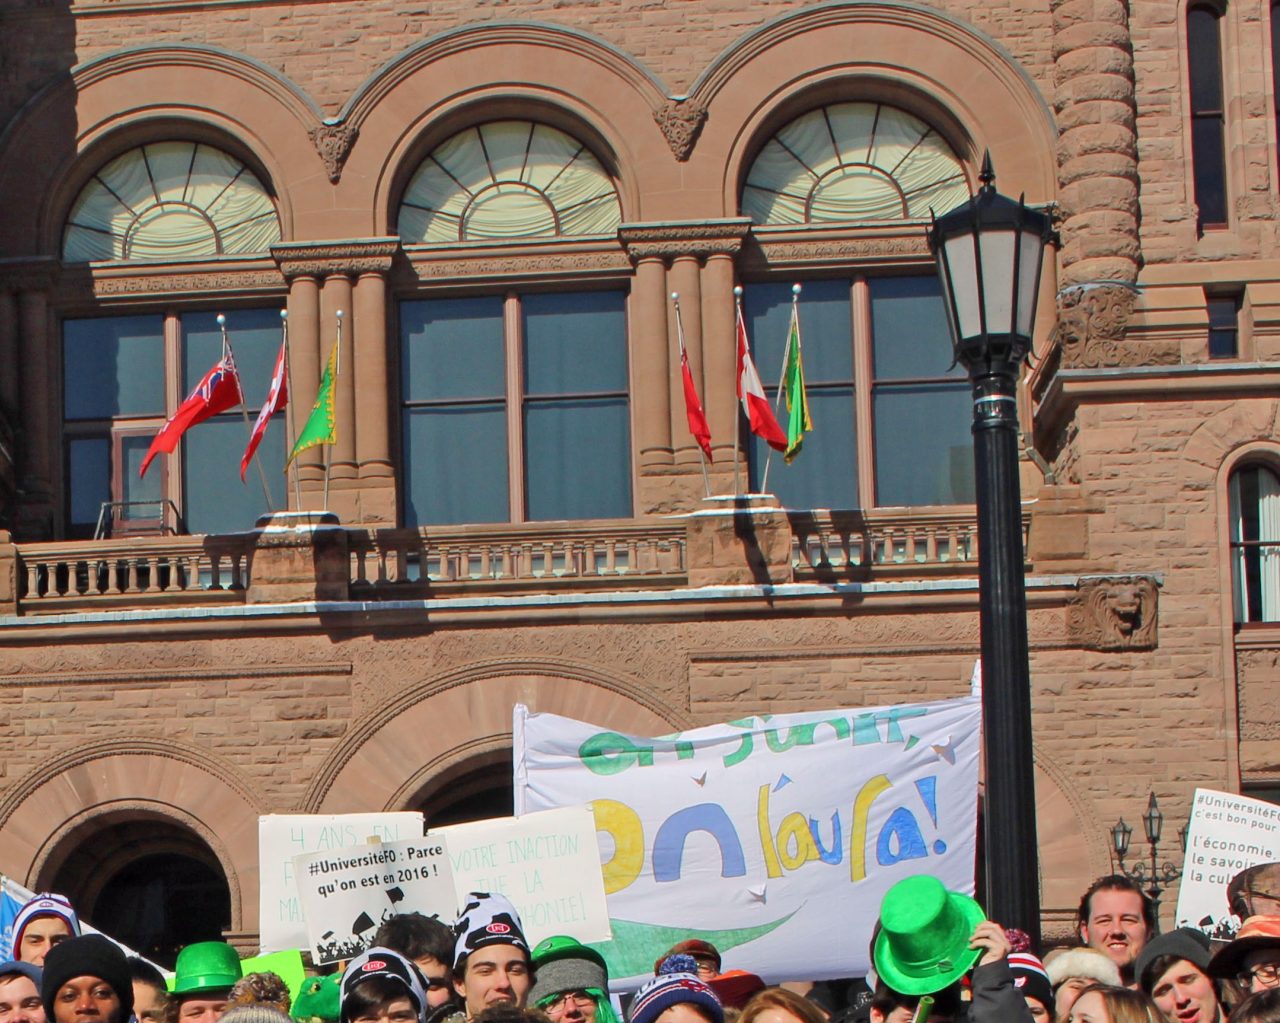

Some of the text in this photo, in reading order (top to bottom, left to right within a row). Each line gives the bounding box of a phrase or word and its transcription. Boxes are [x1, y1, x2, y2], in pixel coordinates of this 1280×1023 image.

[1227, 813, 1248, 826] bon
[1251, 820, 1277, 833] pour
[317, 824, 358, 850] ANS
[506, 833, 580, 864] INACTION
[308, 849, 397, 877] #UniversitéFO
[407, 845, 443, 860] Parce
[1192, 853, 1205, 866] le
[317, 878, 357, 899] qu'on
[360, 873, 380, 888] est
[383, 873, 395, 884] en
[397, 865, 429, 884] 2016
[1190, 869, 1203, 883] la
